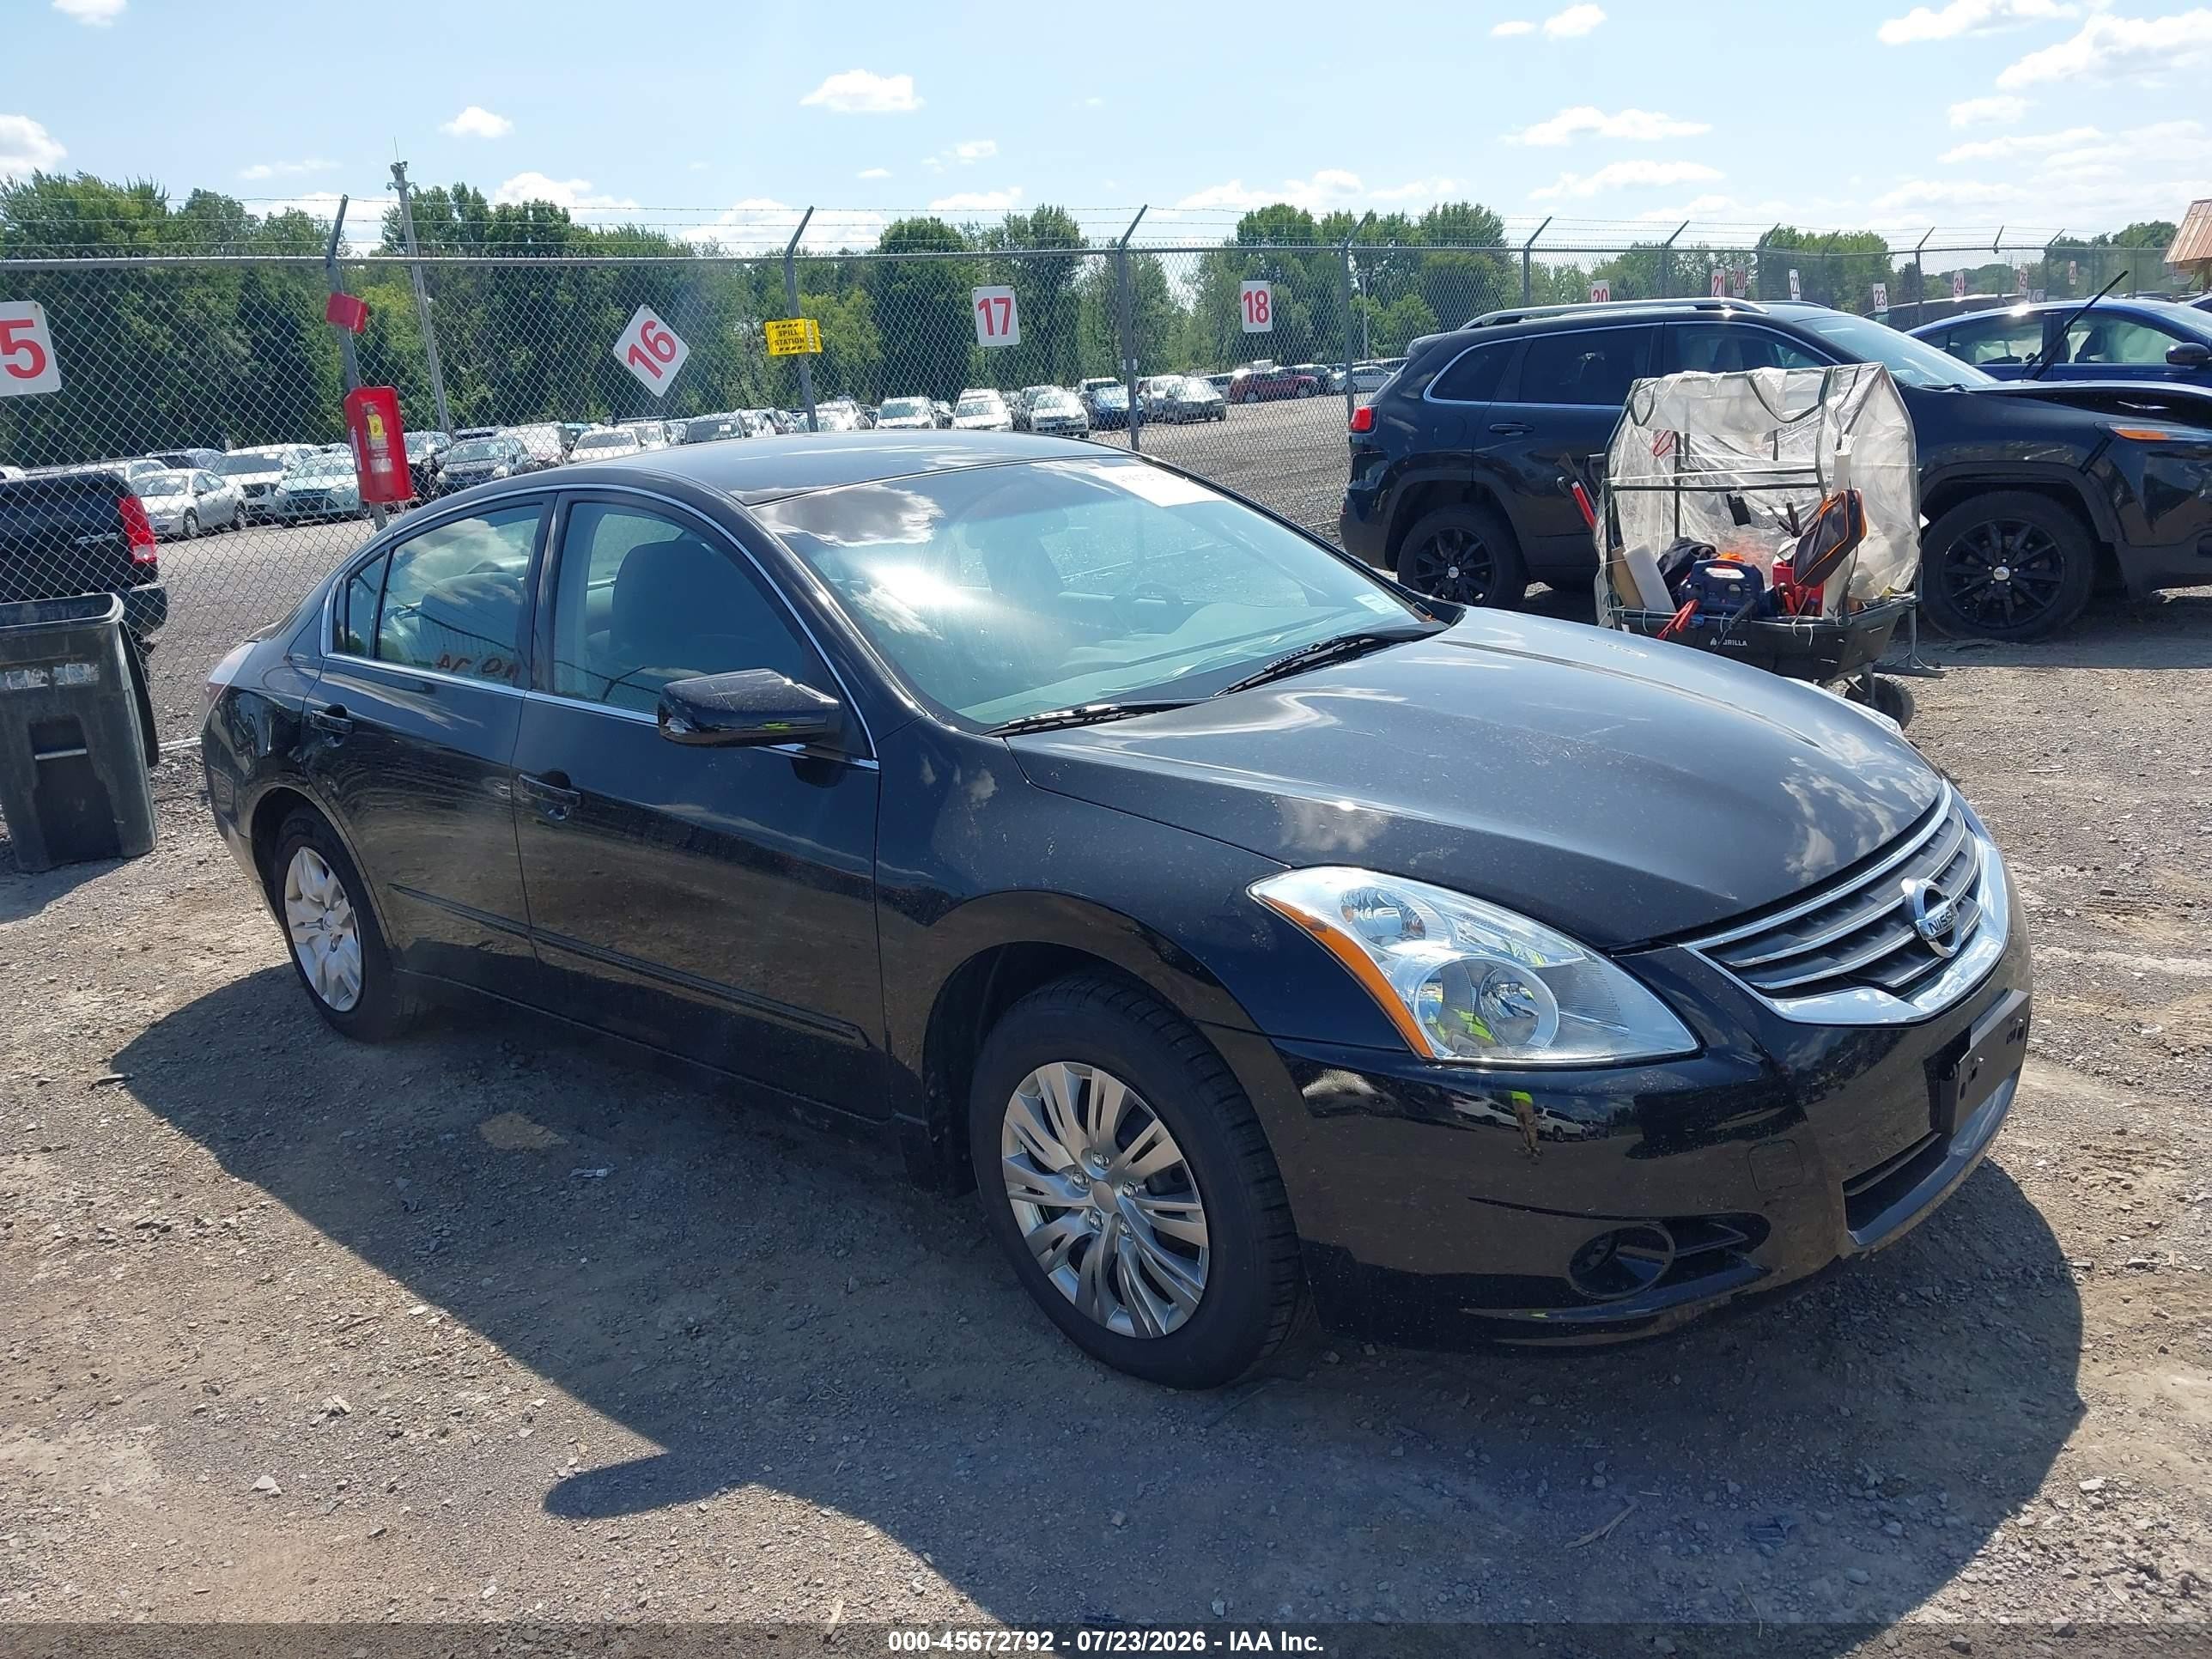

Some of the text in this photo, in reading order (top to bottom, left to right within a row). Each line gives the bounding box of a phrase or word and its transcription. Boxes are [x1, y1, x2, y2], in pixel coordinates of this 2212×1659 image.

[1713, 275, 1724, 297] 21
[1790, 276, 1800, 295] 22
[1954, 276, 1963, 294] 24
[1243, 289, 1270, 324] 18
[1875, 289, 1886, 307] 23
[977, 297, 1012, 337] 17
[775, 337, 805, 346] STATION
[778, 329, 799, 337] SPILL
[0, 319, 46, 379] 5
[628, 319, 677, 380] 16
